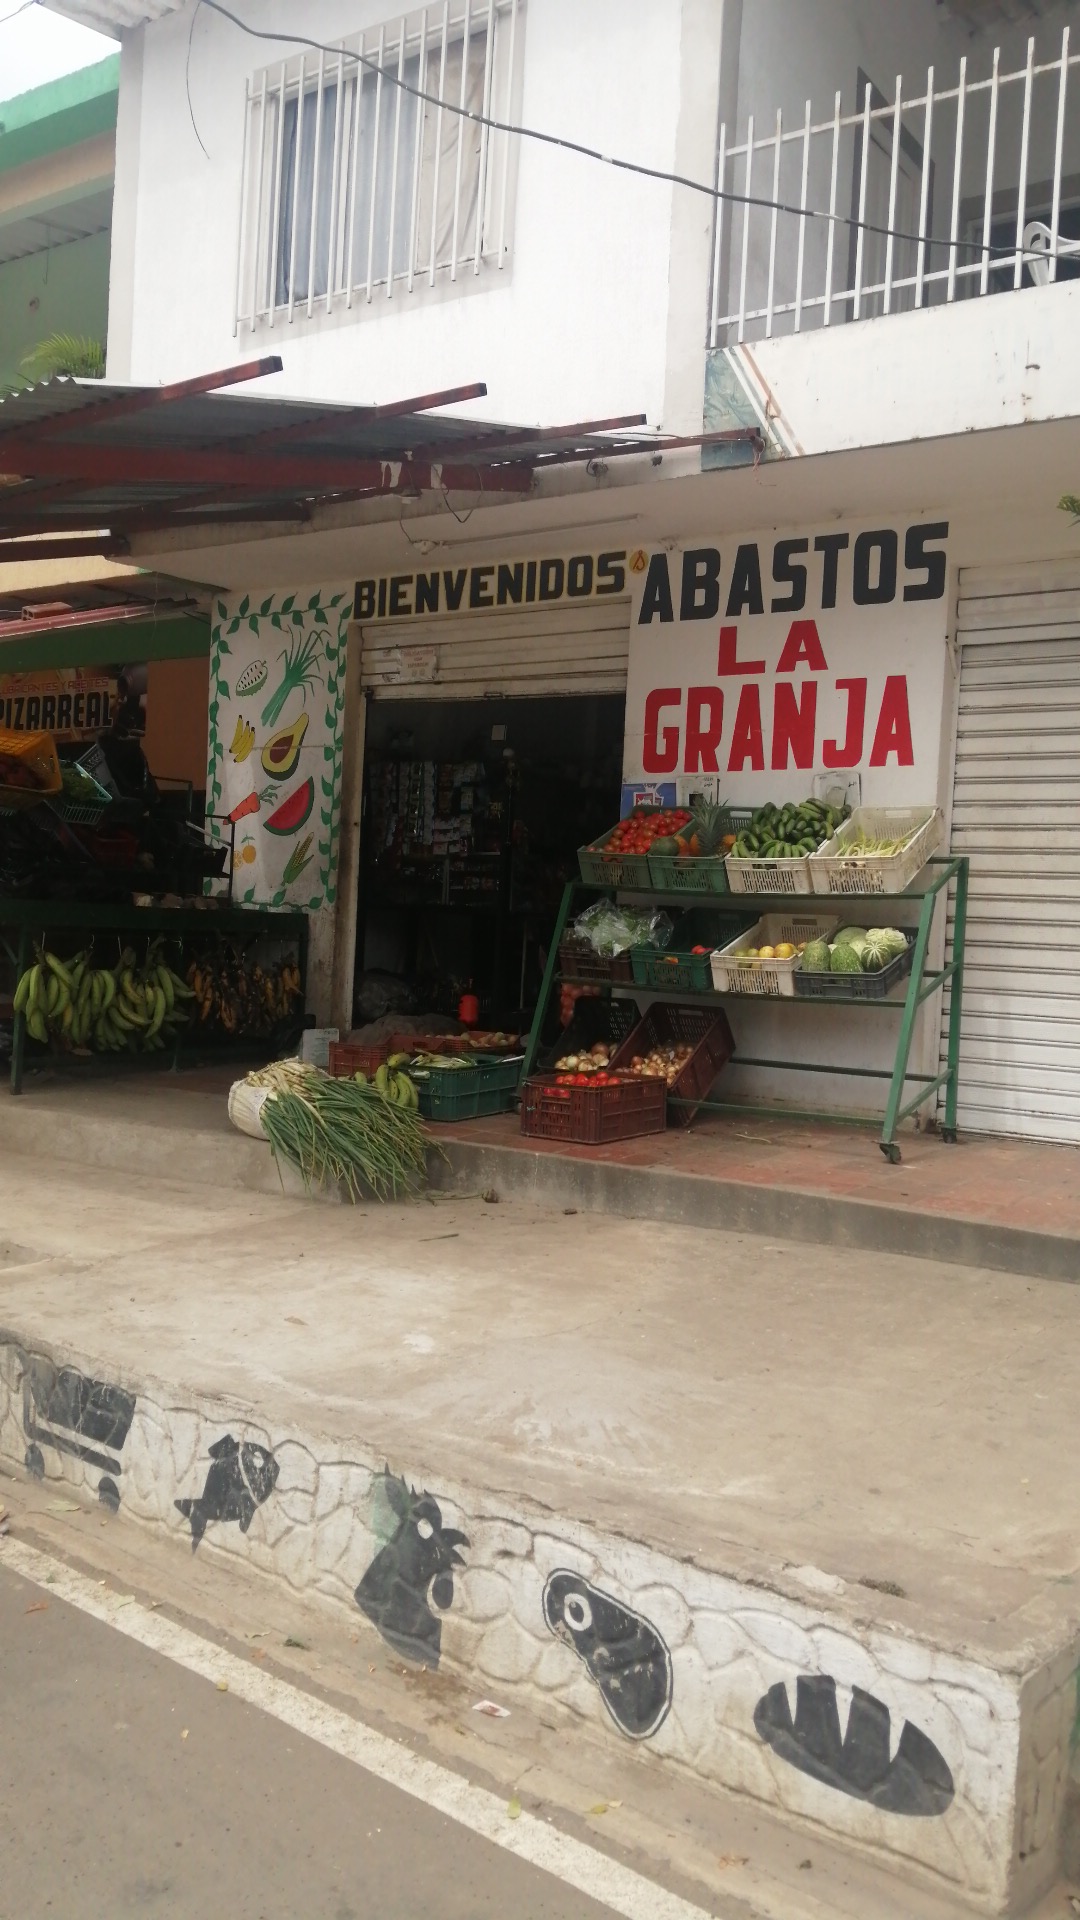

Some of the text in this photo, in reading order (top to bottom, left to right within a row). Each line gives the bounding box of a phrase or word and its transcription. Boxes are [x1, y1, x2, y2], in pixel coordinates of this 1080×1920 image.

[353, 551, 627, 620] BIENVENIDOS
[638, 521, 949, 624] ABASTOS
[717, 619, 828, 676] LA
[642, 673, 914, 774] GRANJA
